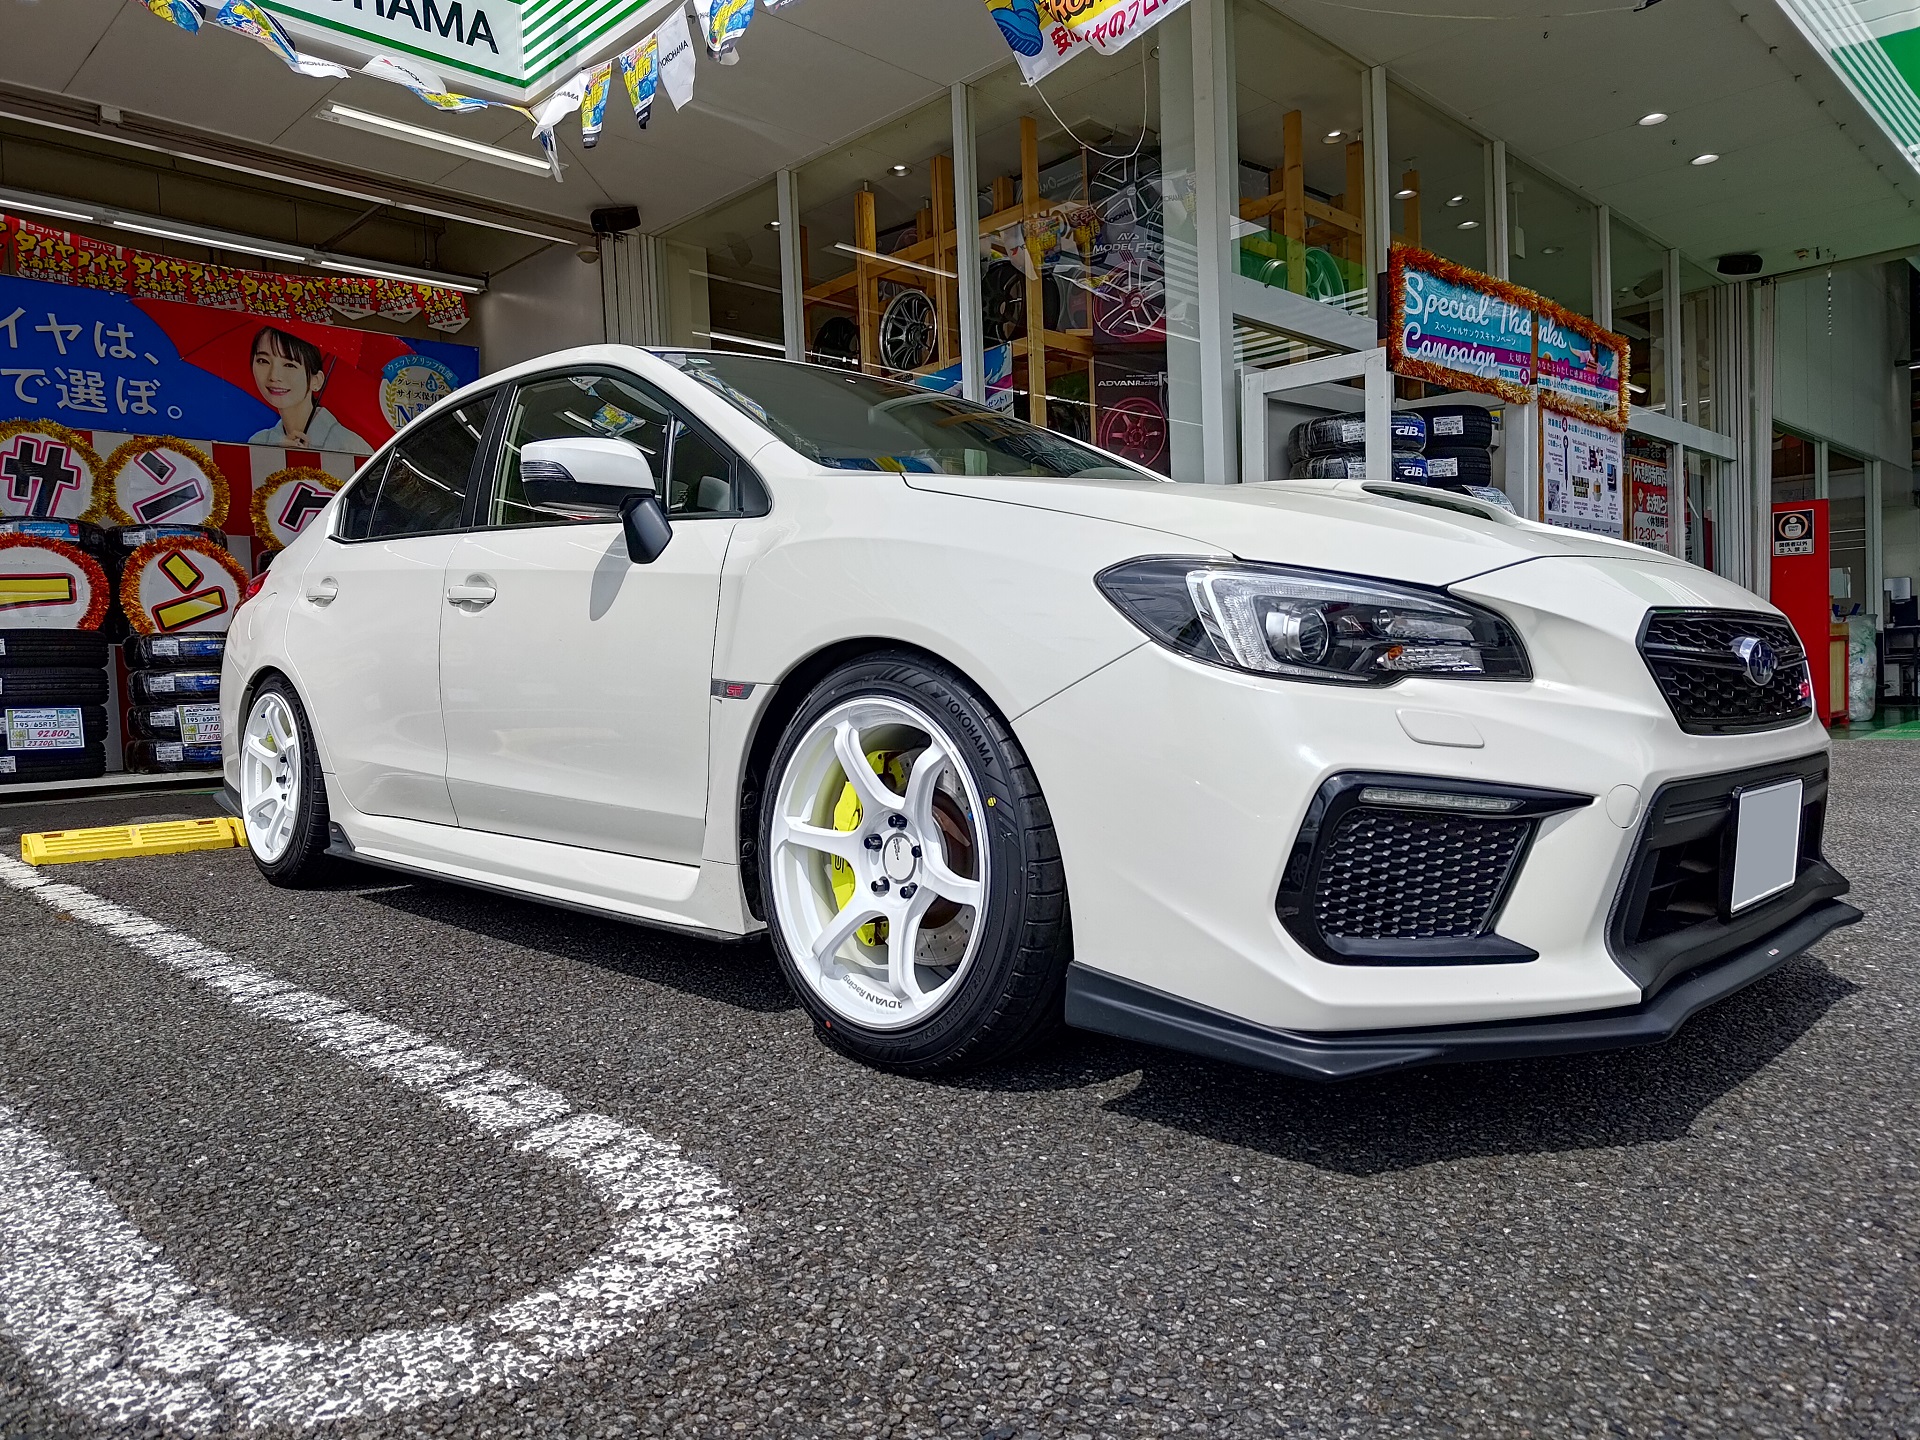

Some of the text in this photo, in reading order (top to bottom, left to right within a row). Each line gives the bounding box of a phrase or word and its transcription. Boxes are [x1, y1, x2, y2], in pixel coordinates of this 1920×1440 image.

[659, 40, 689, 68] YOKOHAMA
[15, 229, 75, 257] タイヤ
[27, 223, 62, 237] ヨコハマ
[132, 254, 187, 277] タイヤ
[1404, 273, 1489, 326] Special
[1435, 321, 1516, 345] スペシャルサンクスキャンペーン
[0, 366, 183, 419] で選ぼ。
[945, 696, 994, 768] YOKOHAMA
[842, 974, 867, 997] Racing
